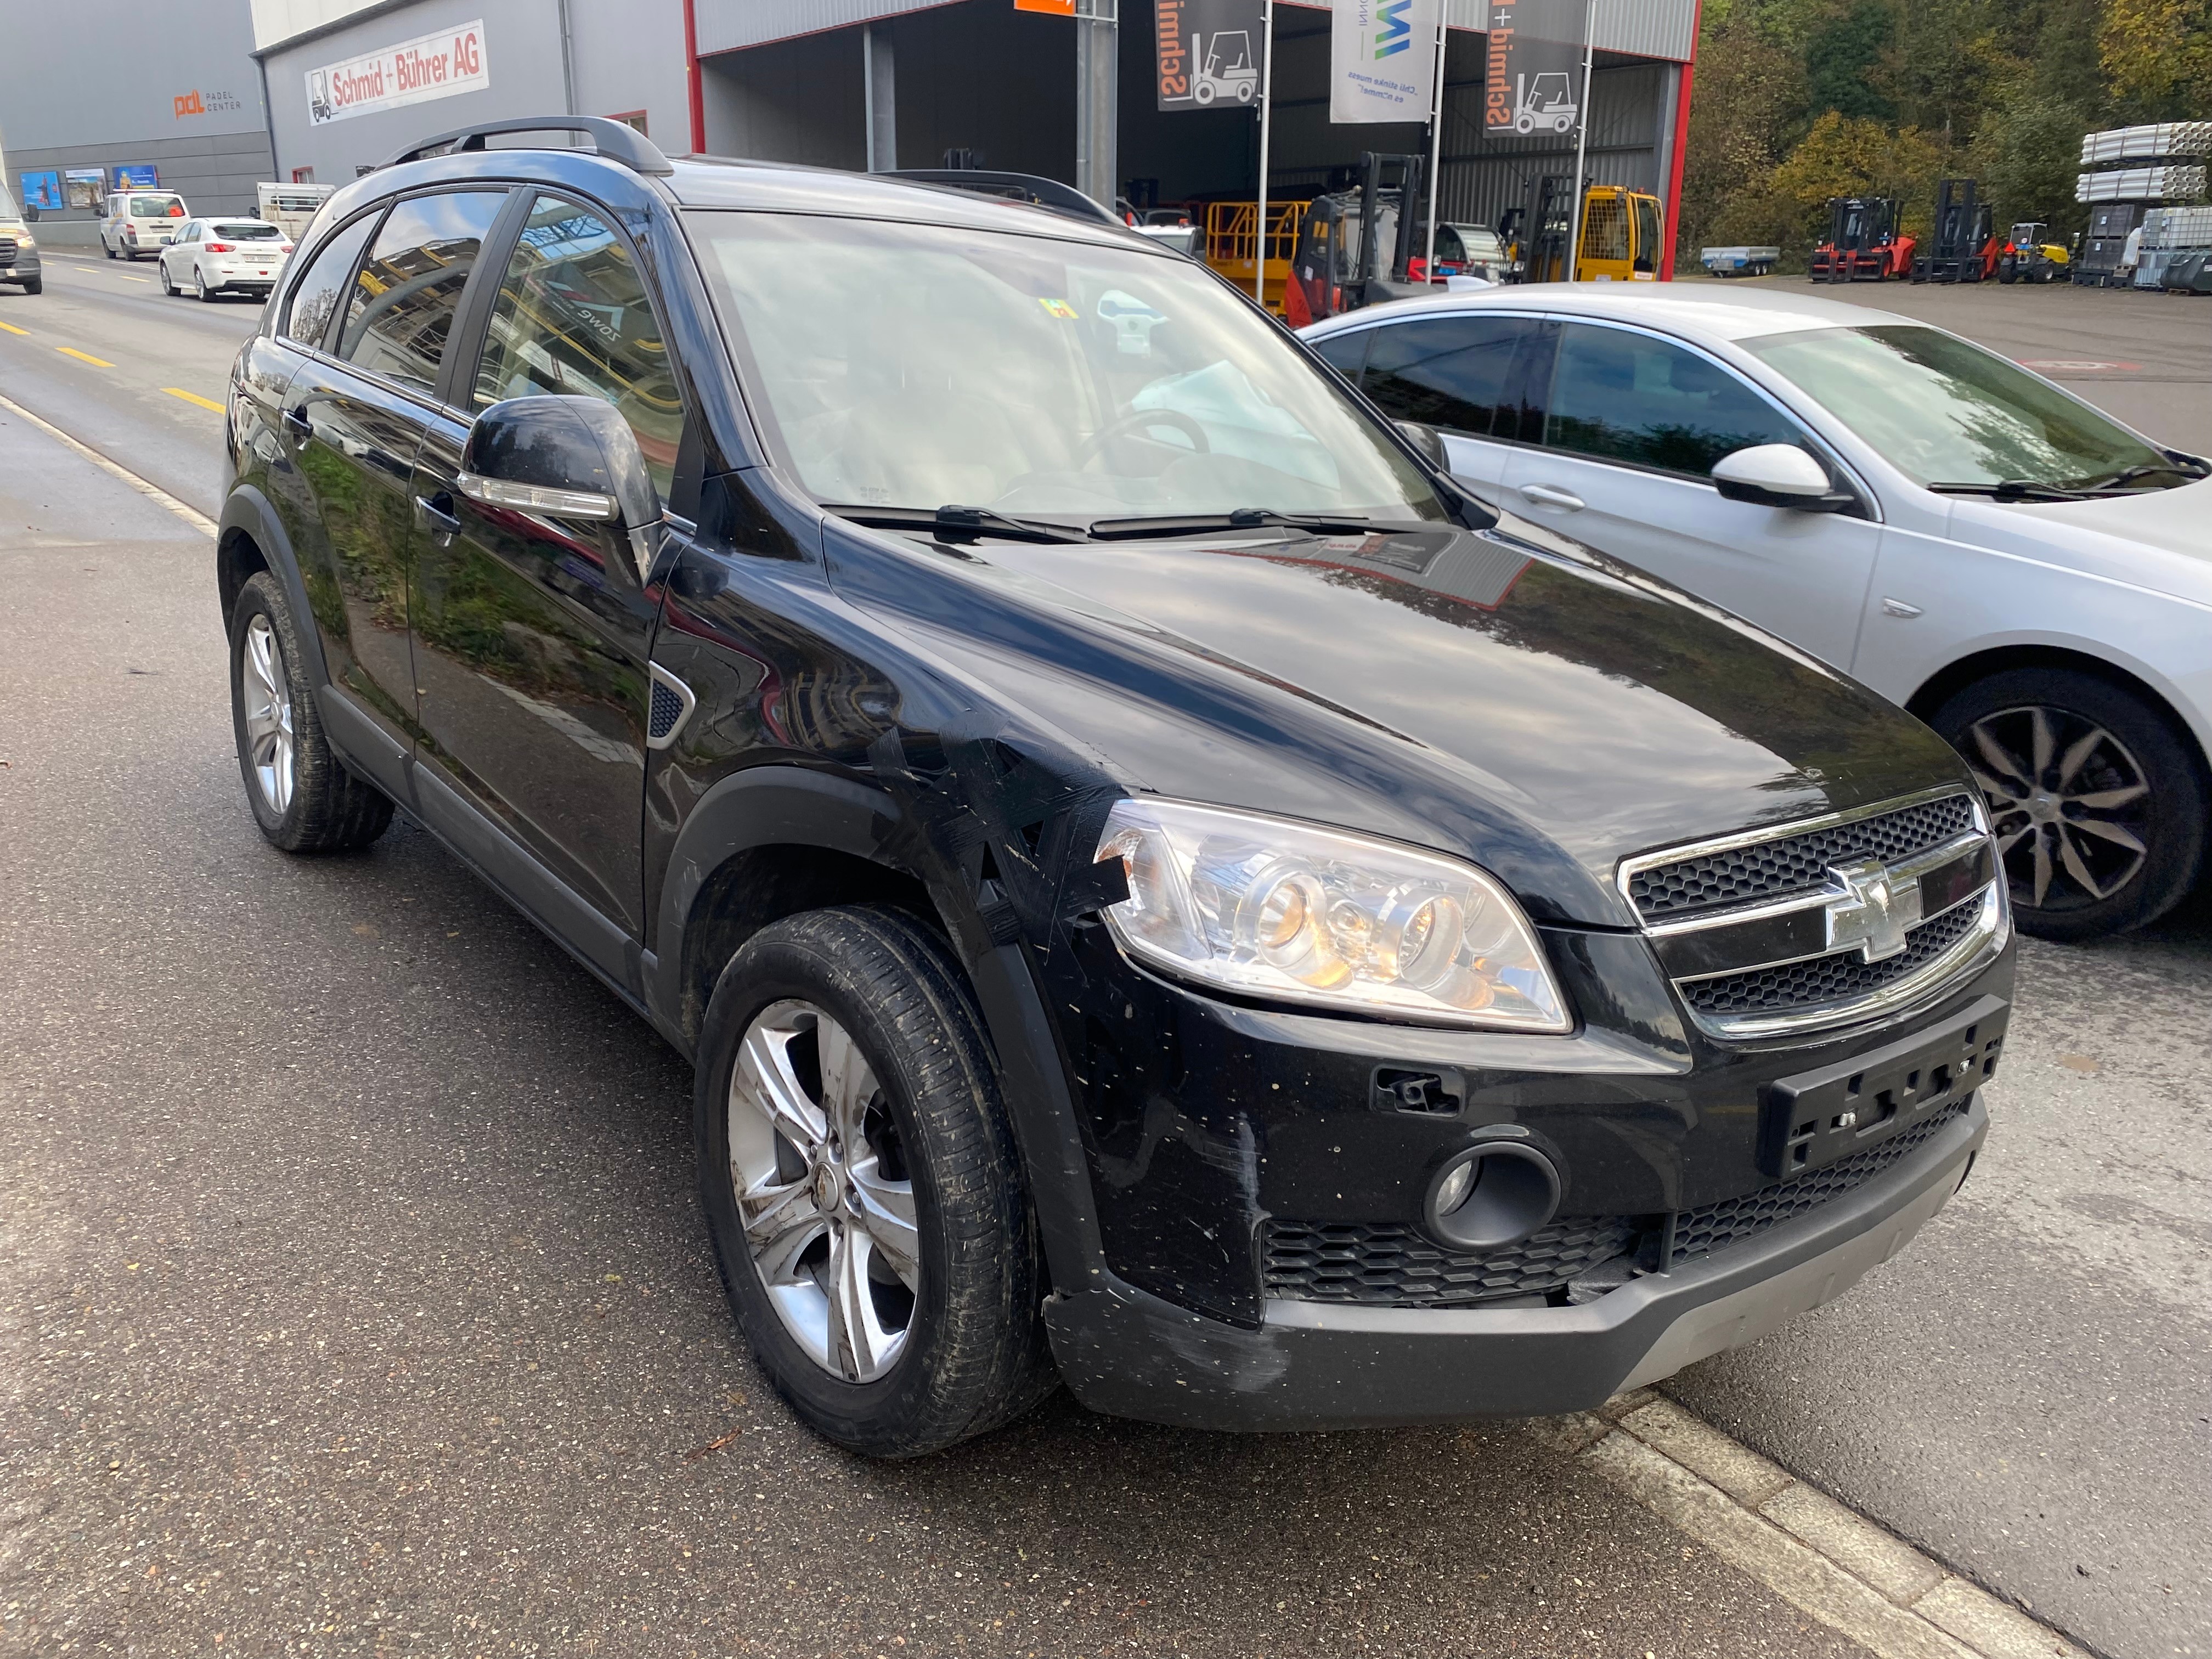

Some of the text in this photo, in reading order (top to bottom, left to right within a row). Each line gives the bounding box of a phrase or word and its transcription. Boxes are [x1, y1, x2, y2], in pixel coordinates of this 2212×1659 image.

[332, 32, 479, 106] Schmid + Bührer AG
[206, 91, 233, 100] PADEL
[207, 101, 241, 111] CENTER
